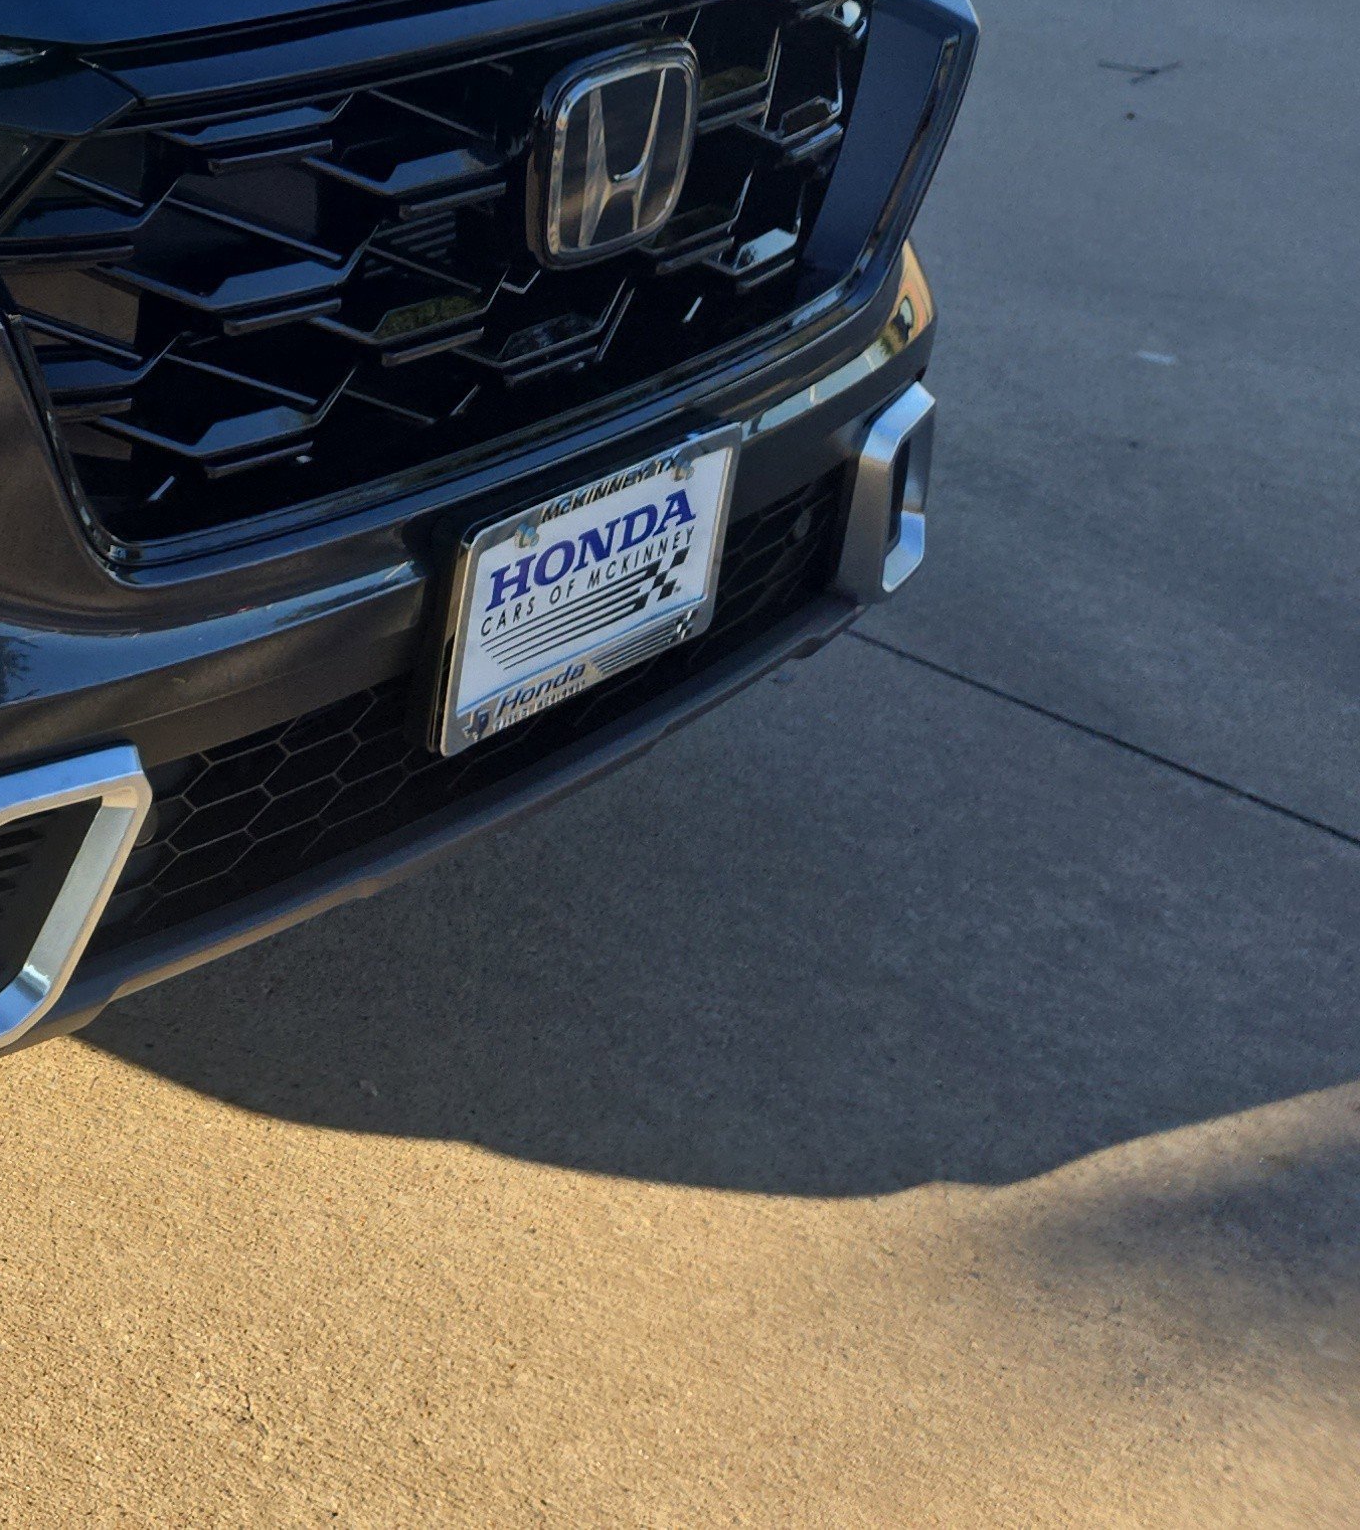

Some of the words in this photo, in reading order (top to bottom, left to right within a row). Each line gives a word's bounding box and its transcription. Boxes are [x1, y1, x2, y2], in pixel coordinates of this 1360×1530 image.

[481, 595, 535, 637] CARS
[549, 578, 576, 605] OF
[587, 525, 695, 589] MCKINNEY
[484, 488, 696, 612] HONDA
